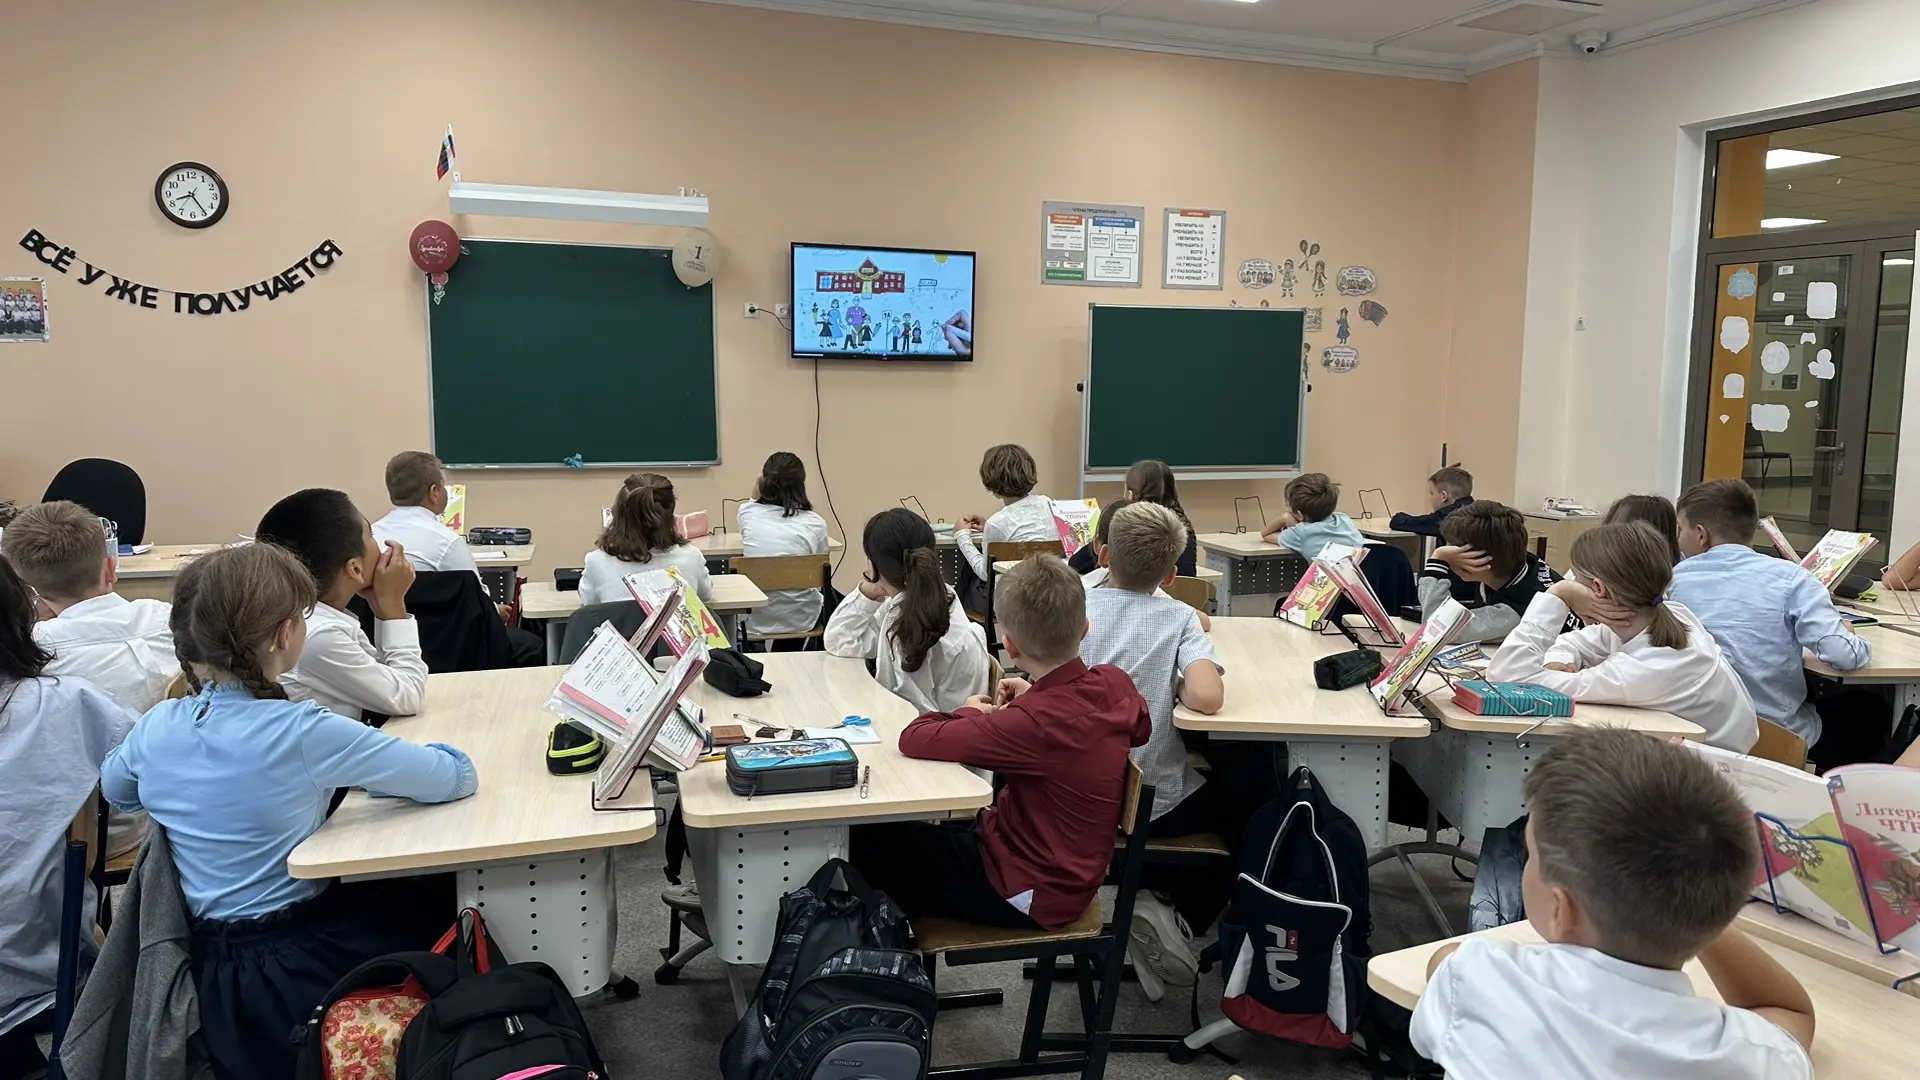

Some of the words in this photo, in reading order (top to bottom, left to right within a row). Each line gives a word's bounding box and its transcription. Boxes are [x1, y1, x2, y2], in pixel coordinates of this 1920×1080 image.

[186, 171, 197, 179] 12
[201, 175, 205, 183] 1
[169, 181, 179, 189] 10
[208, 183, 215, 191] 2
[165, 190, 172, 198] 9
[695, 245, 702, 260] 1
[19, 228, 76, 274] ВСЁ
[174, 238, 343, 315] ПОЛУЧАЕТСЯ
[446, 512, 461, 530] 4
[1315, 586, 1337, 612] 4
[700, 608, 720, 638] 4
[1265, 924, 1300, 992] FILA
